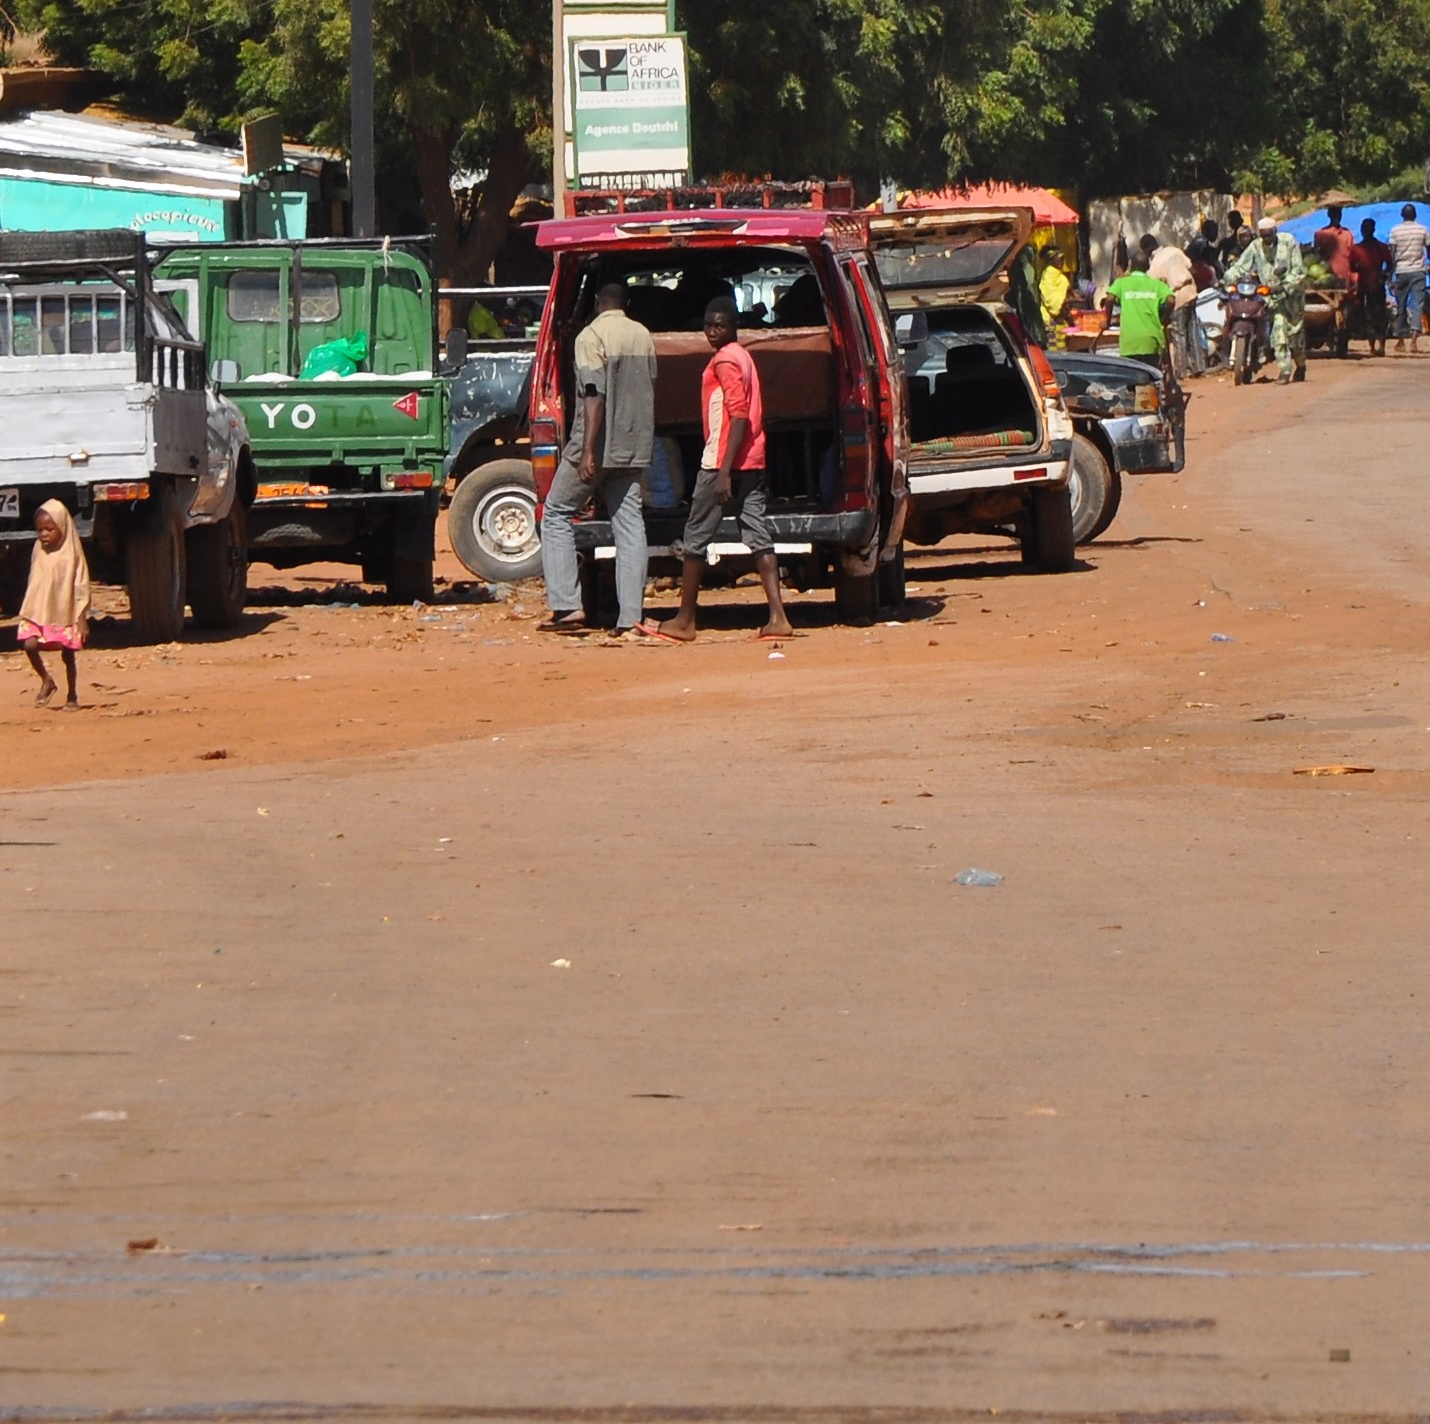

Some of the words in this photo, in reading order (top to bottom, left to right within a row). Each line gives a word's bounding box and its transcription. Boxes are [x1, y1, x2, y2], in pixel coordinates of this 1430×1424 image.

[629, 42, 667, 53] BANK
[629, 56, 648, 67] OF
[631, 67, 679, 80] AFRICA
[584, 125, 629, 138] Agence
